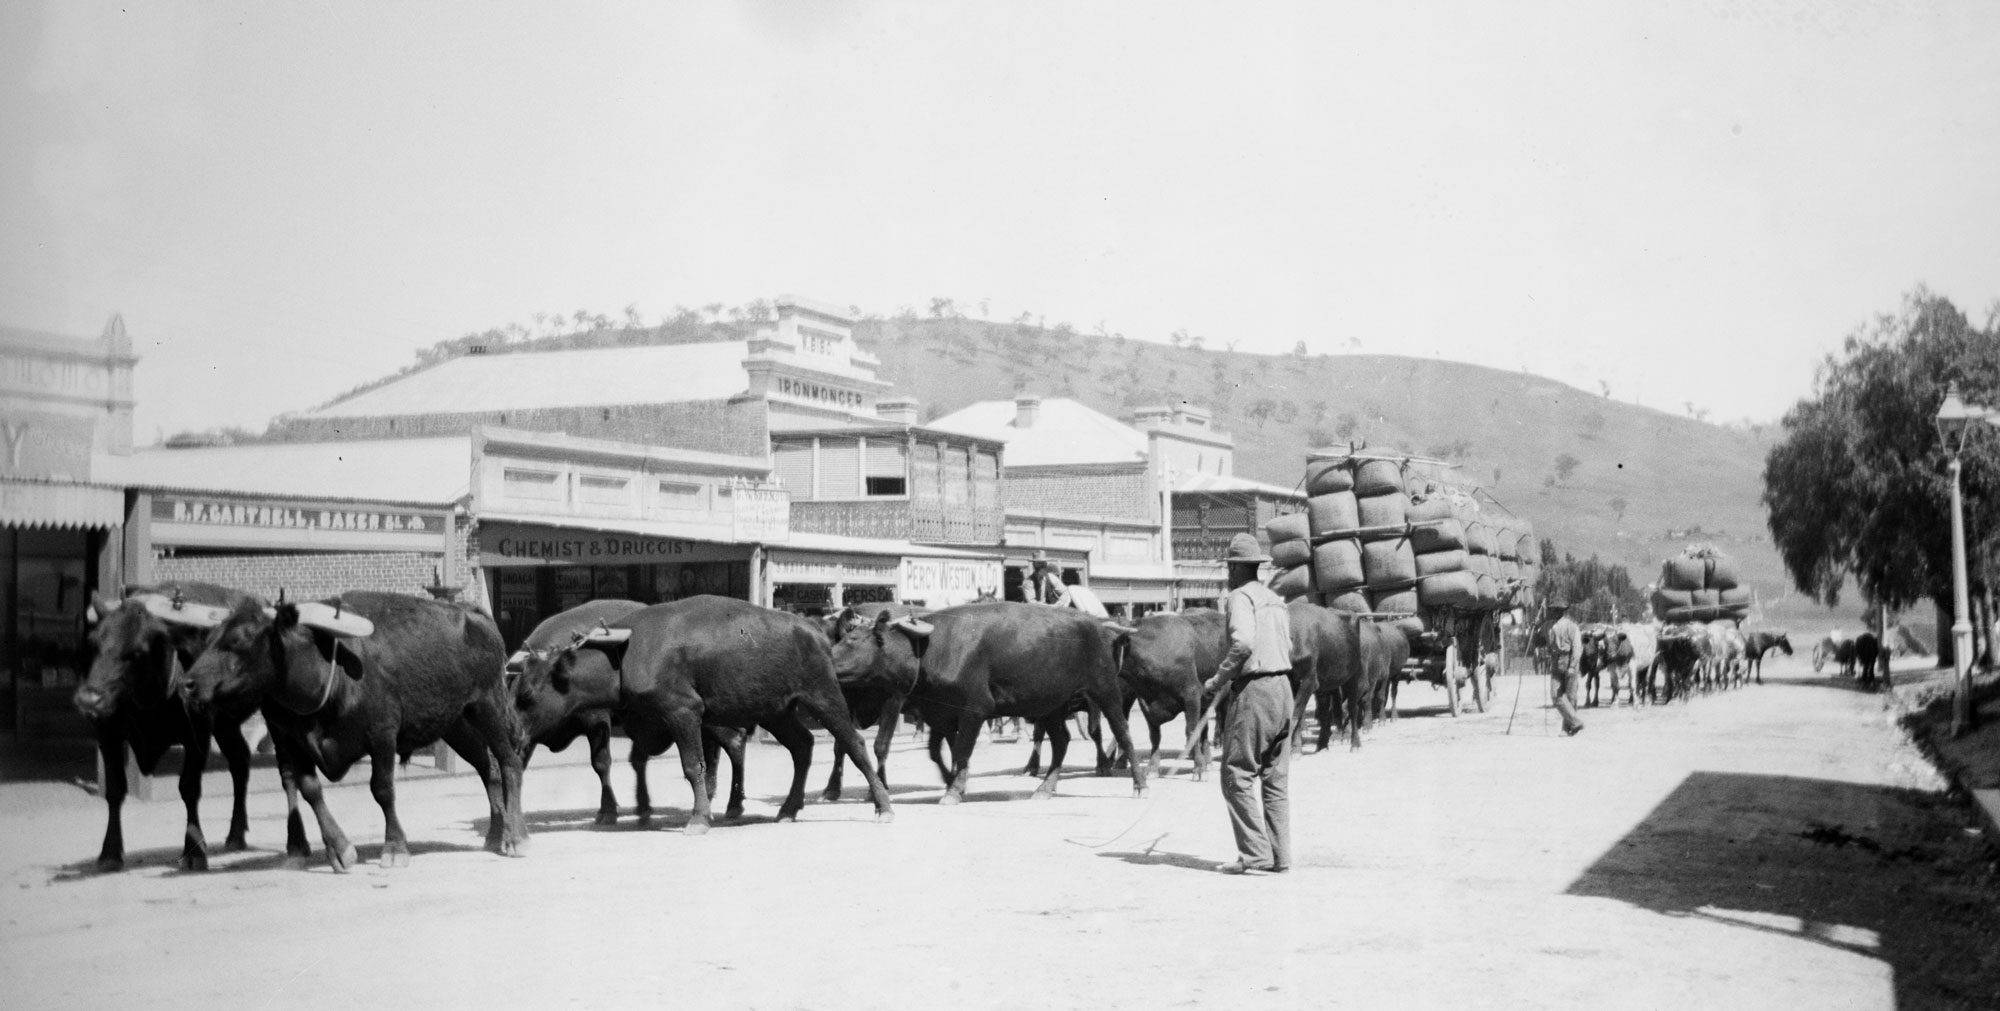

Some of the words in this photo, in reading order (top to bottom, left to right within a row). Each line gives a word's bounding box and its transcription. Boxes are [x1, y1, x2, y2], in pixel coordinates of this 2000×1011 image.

[777, 376, 862, 408] IRONMONGER
[320, 510, 379, 530] BAKER
[498, 538, 585, 558] CHEMIST
[588, 540, 601, 556] &
[606, 538, 696, 556] DRUGGIST
[906, 559, 937, 591] PERCY
[938, 560, 976, 591] WESTON
